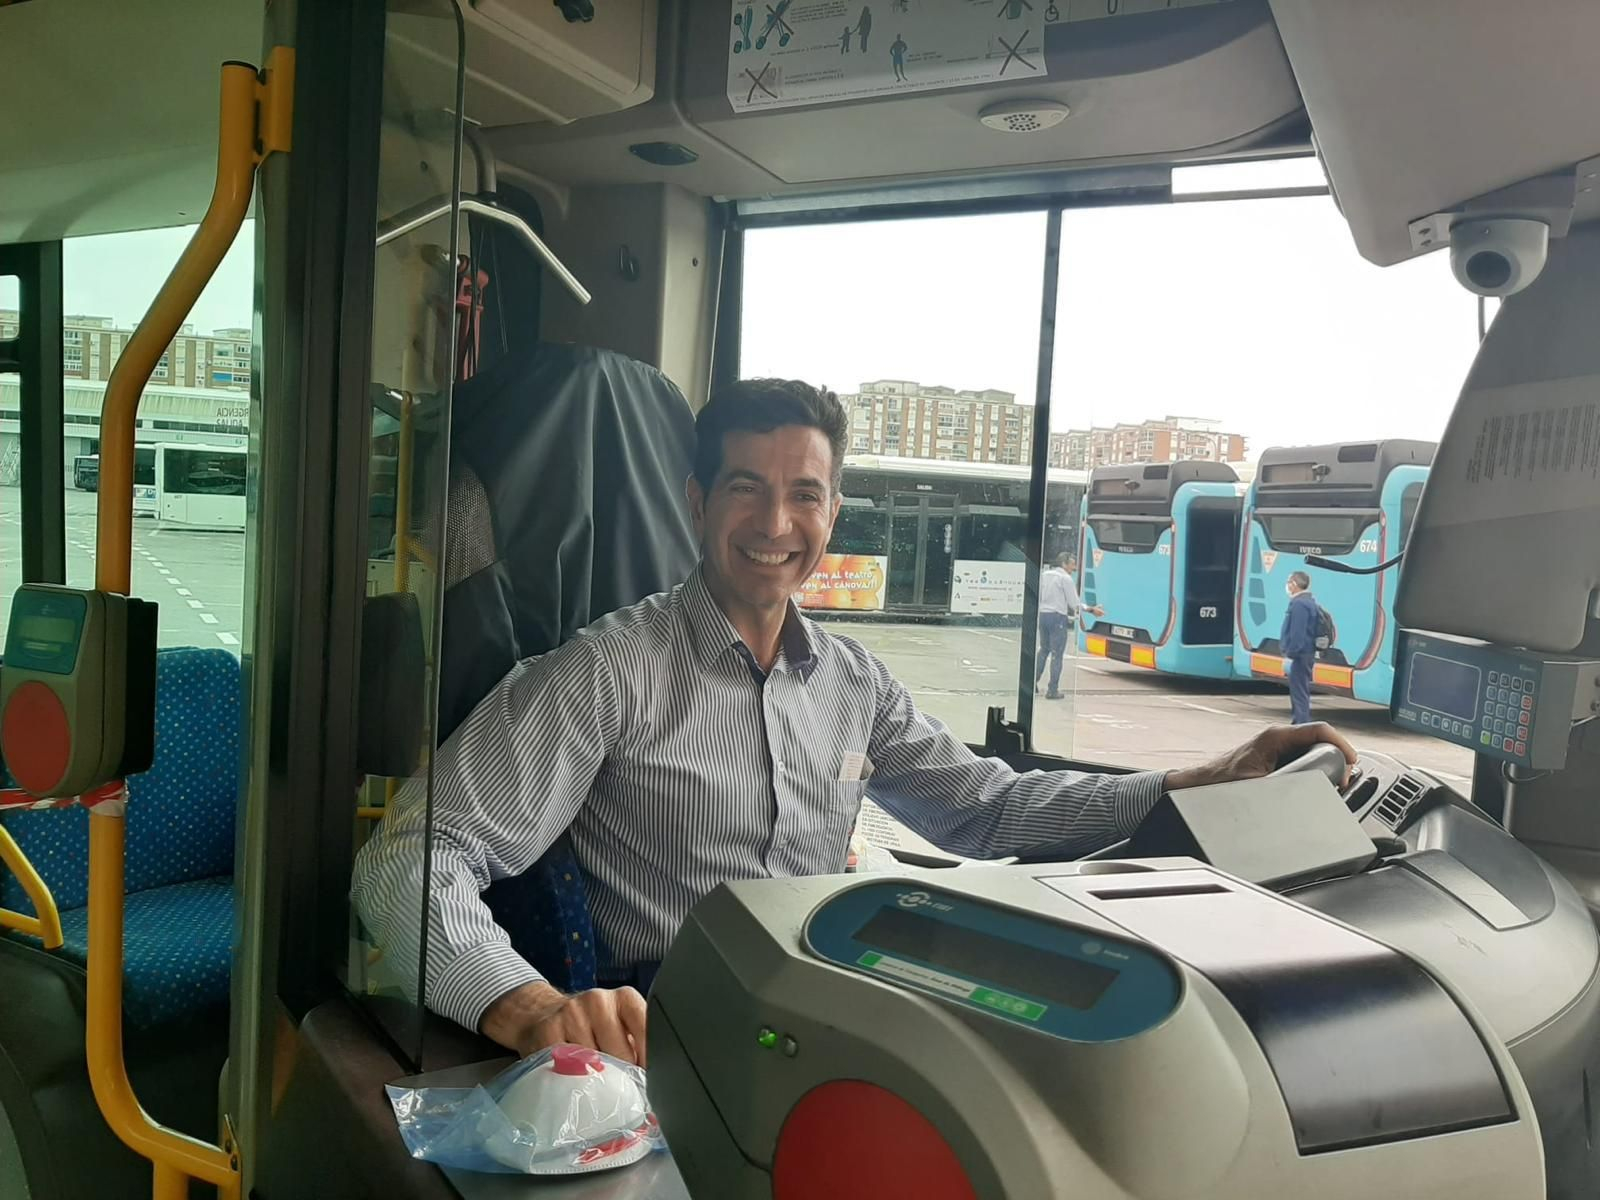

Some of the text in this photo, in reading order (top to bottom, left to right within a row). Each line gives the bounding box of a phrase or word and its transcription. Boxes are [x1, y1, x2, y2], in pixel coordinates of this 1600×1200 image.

[1299, 546, 1322, 555] IVECO
[1360, 540, 1377, 553] 674
[1200, 606, 1217, 618] 673
